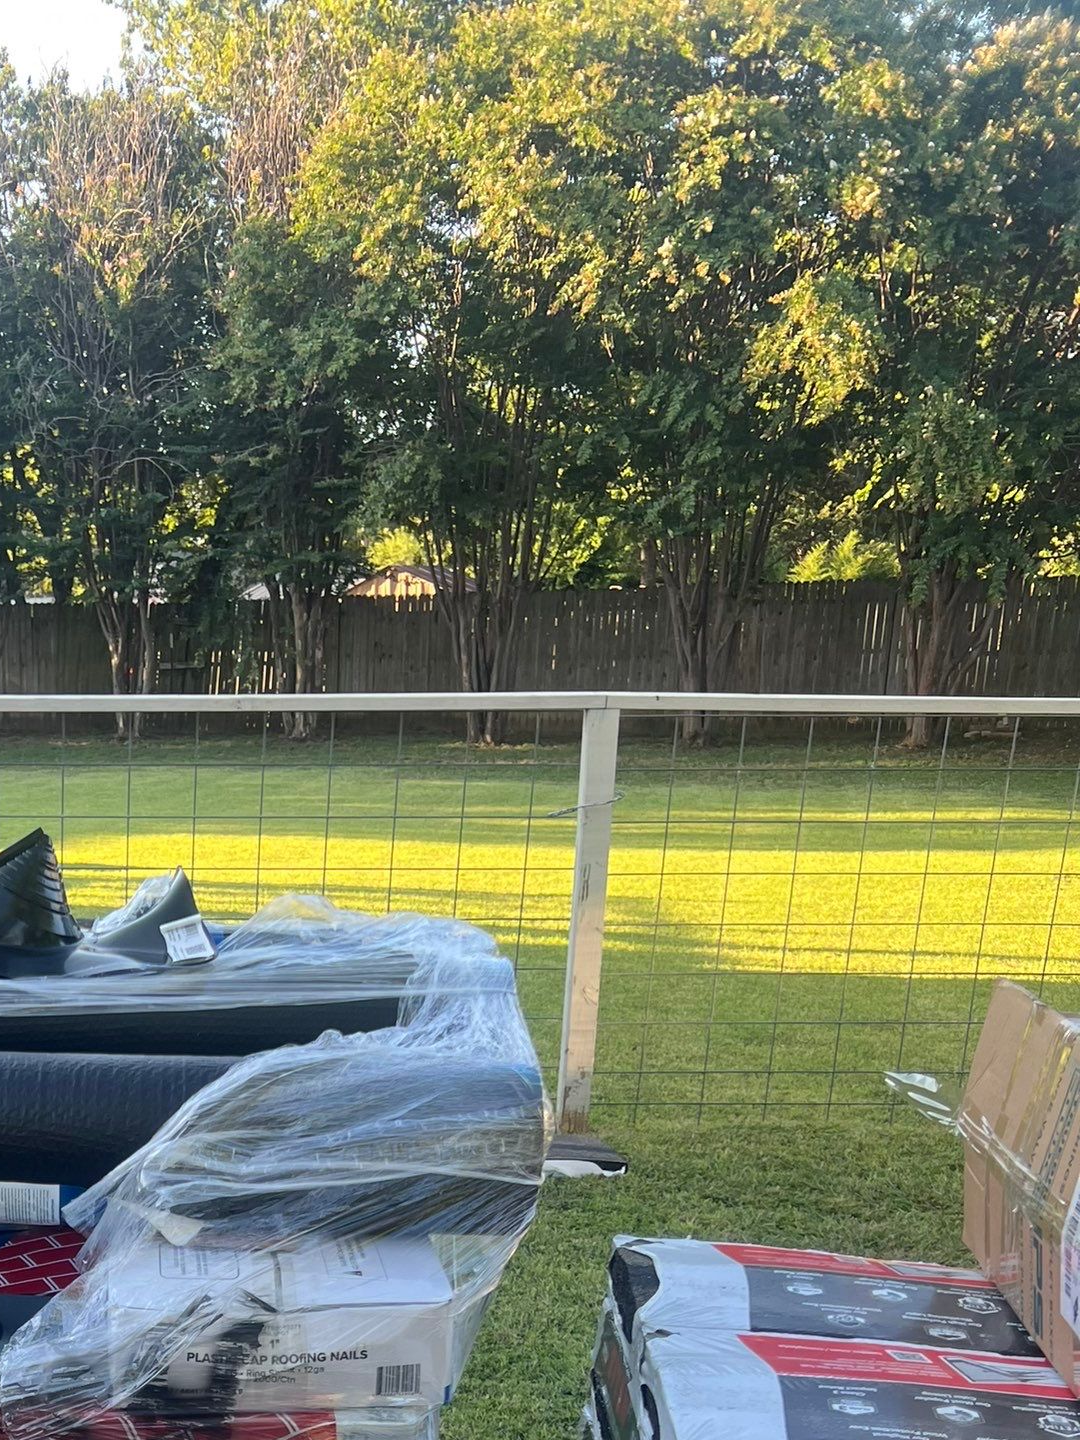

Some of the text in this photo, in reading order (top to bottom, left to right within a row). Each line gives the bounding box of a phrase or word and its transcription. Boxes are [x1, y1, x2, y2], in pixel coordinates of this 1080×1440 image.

[330, 1349, 369, 1362] NAILS
[246, 1366, 325, 1379] Ring 12ga
